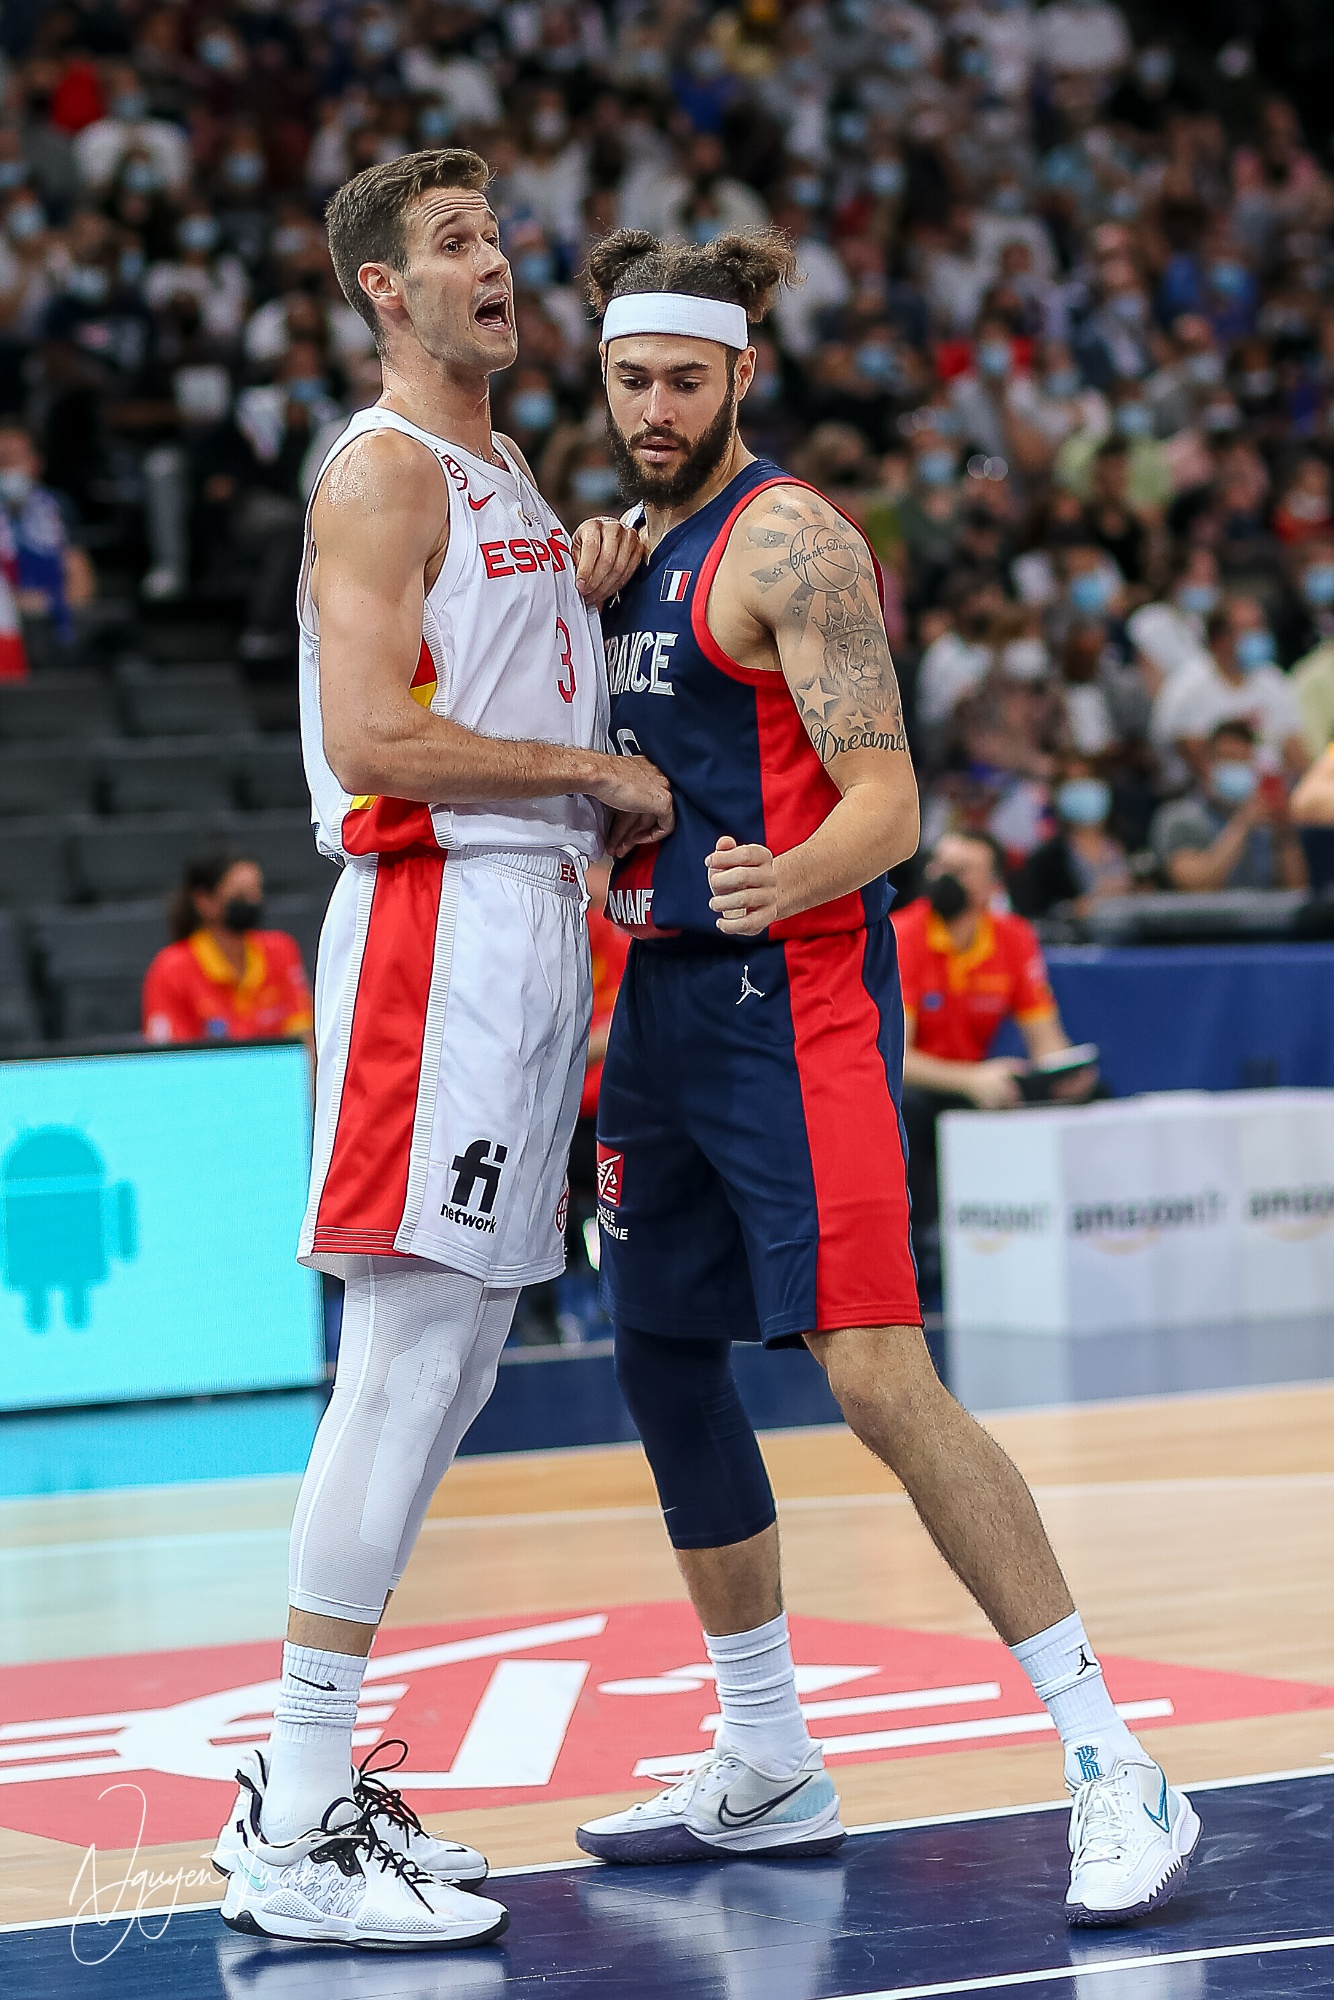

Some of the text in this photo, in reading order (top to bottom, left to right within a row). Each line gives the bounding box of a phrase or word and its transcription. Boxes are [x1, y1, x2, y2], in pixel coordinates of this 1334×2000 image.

[556, 617, 576, 703] 3
[605, 631, 679, 696] RANCE
[608, 889, 654, 925] MAIF
[450, 1139, 508, 1214] fi
[440, 1203, 497, 1234] network
